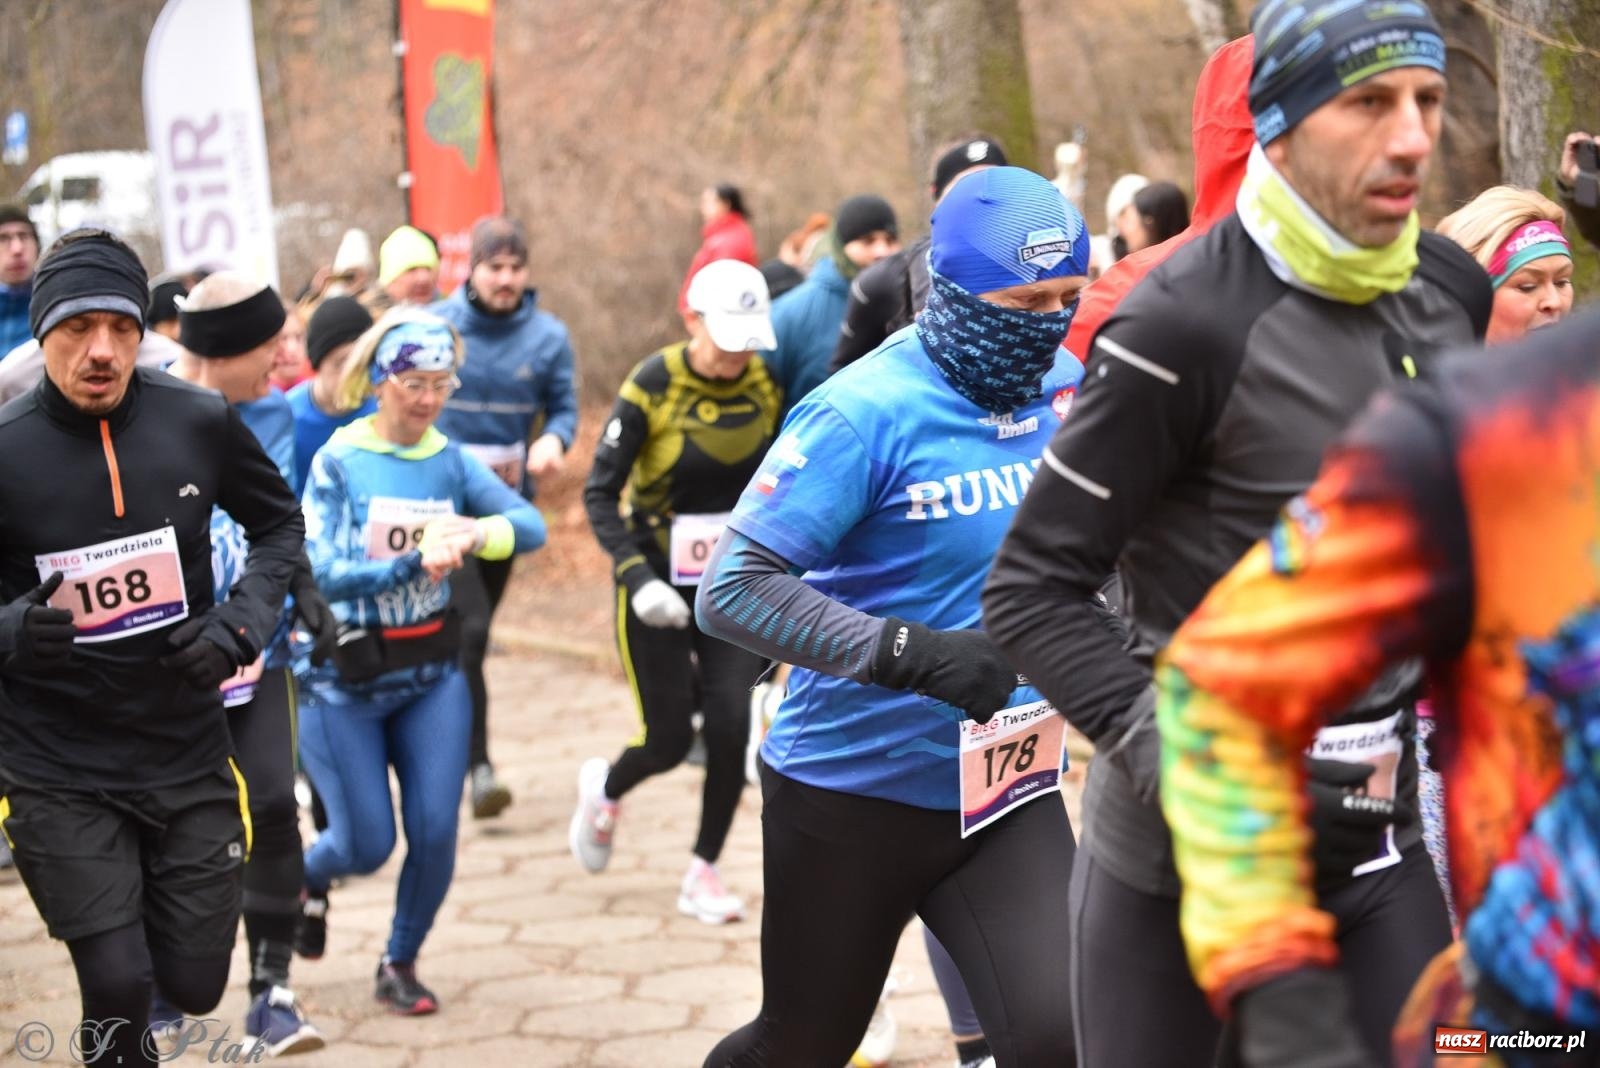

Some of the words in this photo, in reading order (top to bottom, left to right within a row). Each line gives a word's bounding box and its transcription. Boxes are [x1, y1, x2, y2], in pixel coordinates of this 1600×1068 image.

[169, 113, 236, 271] SiR
[50, 555, 81, 569] BIEG
[84, 536, 163, 563] Twardziela
[74, 568, 152, 615] 168
[970, 718, 999, 735] BIEG
[983, 733, 1039, 789] 178
